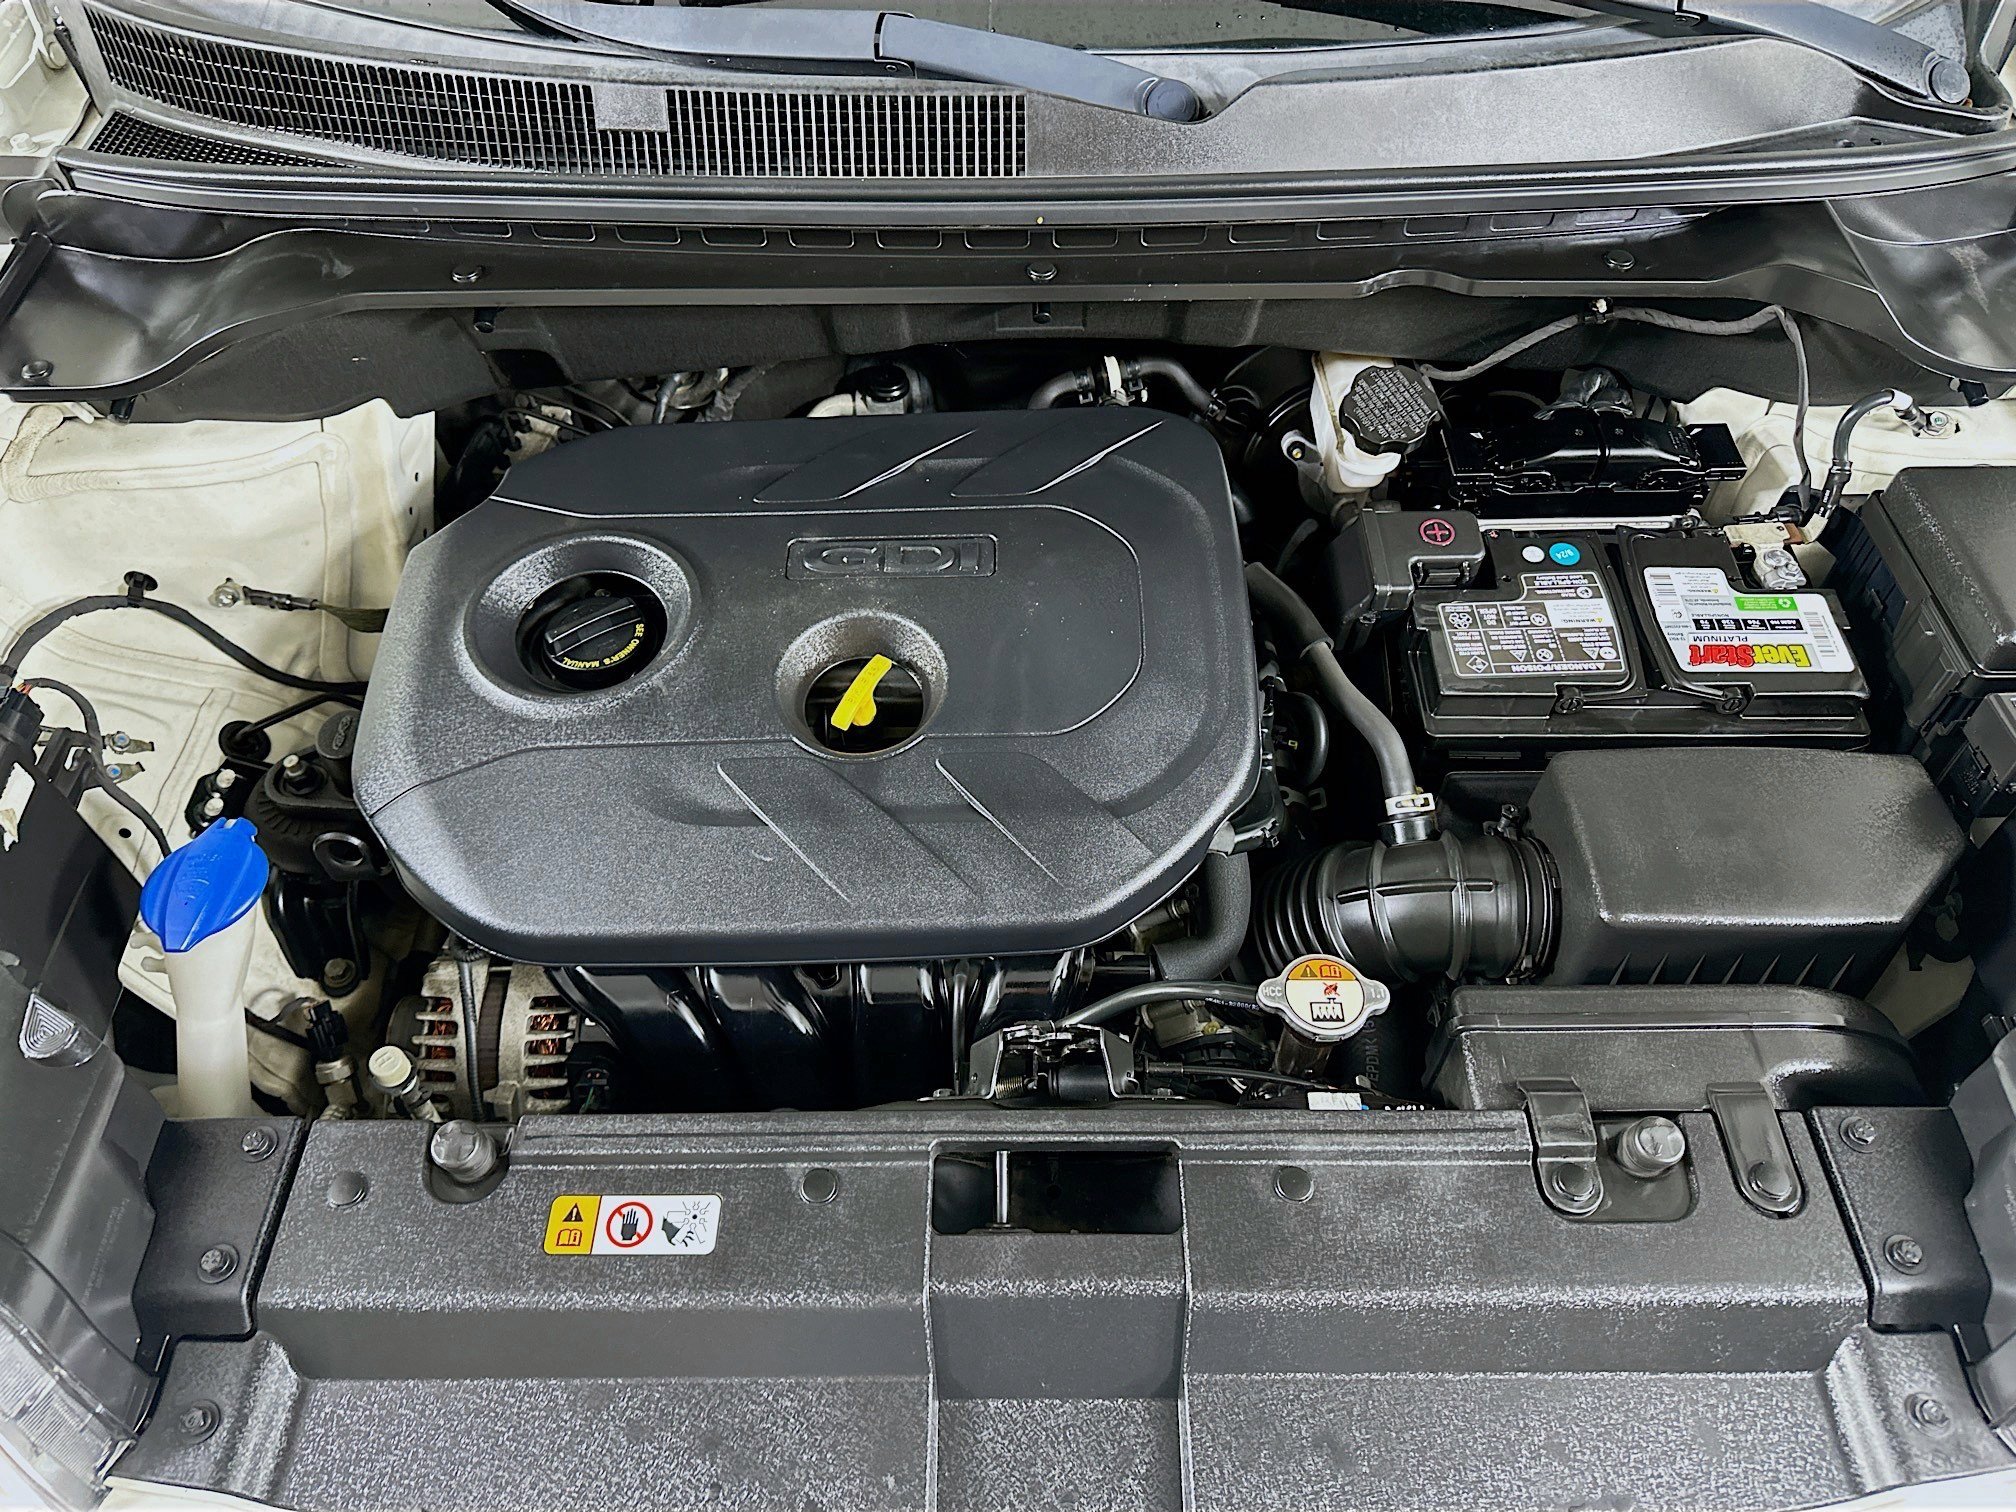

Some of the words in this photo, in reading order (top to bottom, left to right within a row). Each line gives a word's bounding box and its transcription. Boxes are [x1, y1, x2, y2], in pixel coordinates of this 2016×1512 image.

[803, 542, 979, 573] GDI
[634, 623, 644, 637] SEE
[603, 639, 640, 665] OWNER'S
[1689, 645, 1811, 668] EverStart
[563, 657, 600, 668] MANUAL
[1262, 986, 1282, 996] HCC
